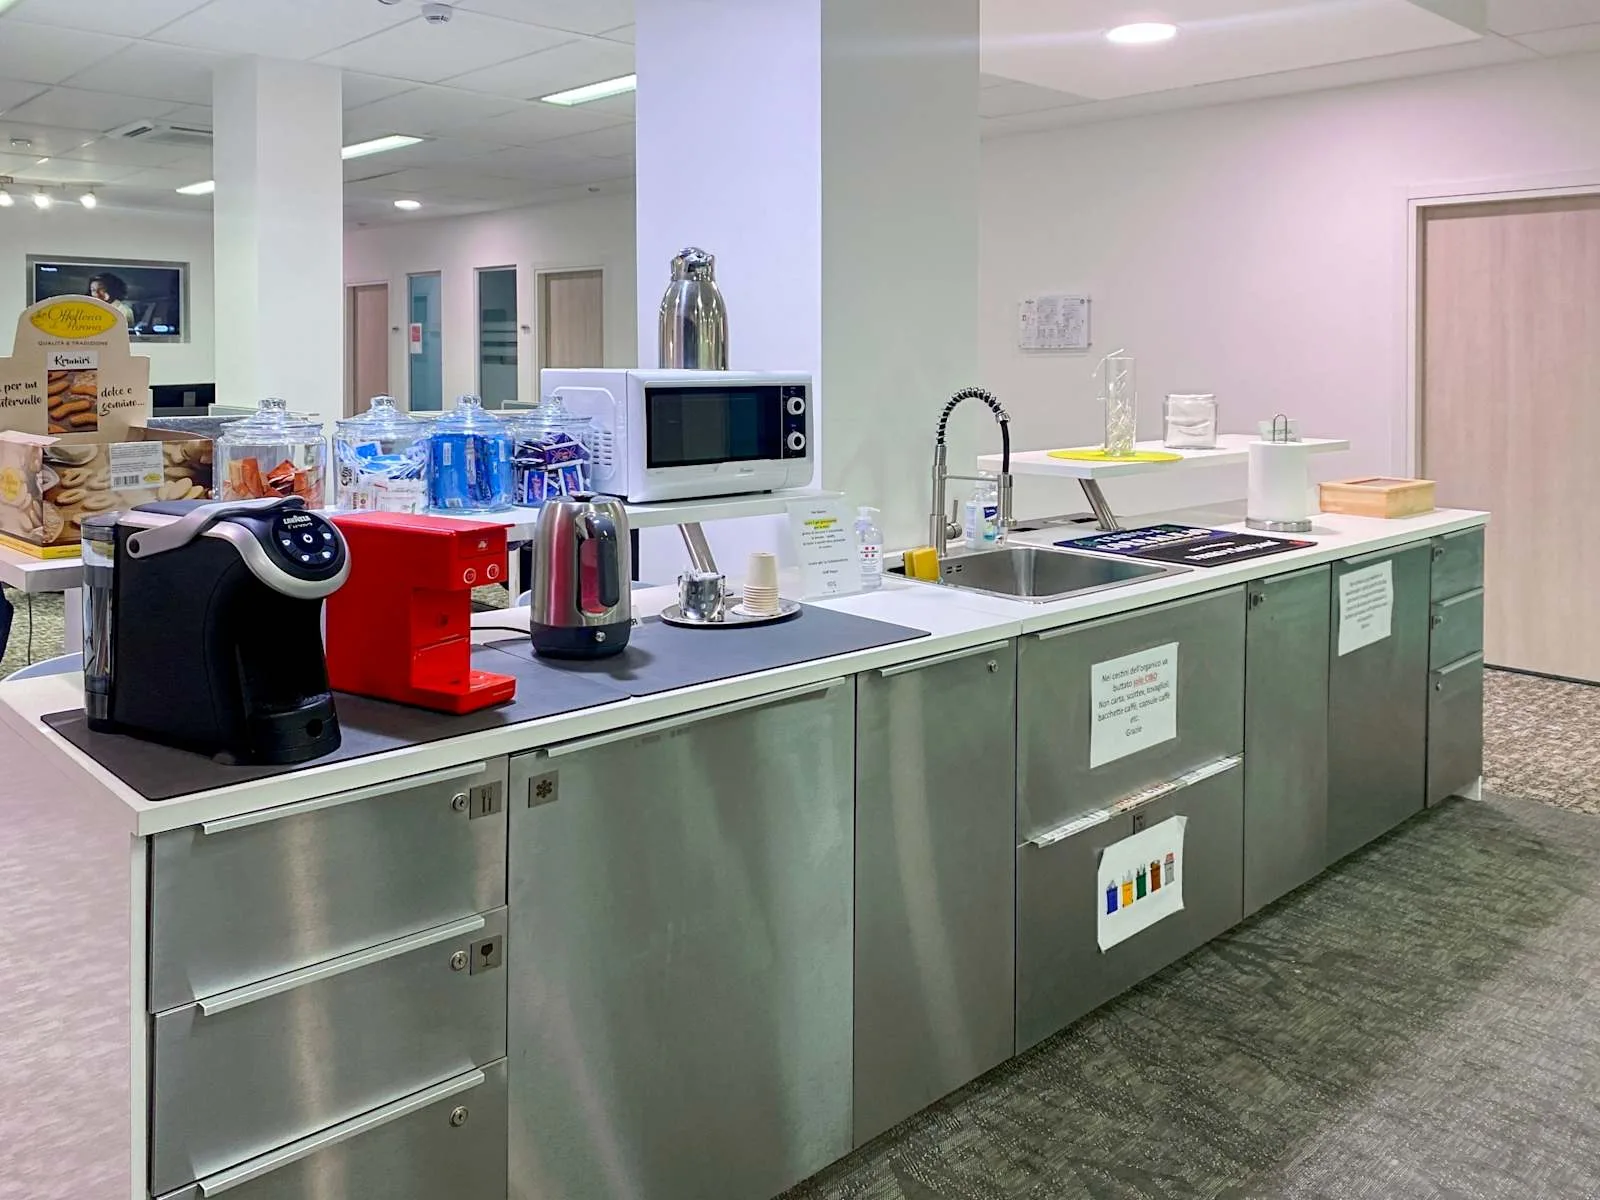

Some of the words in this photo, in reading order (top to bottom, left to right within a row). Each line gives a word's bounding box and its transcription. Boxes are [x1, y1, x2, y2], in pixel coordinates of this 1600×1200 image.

[4, 383, 22, 395] per
[101, 386, 125, 398] dolce
[127, 387, 134, 395] e
